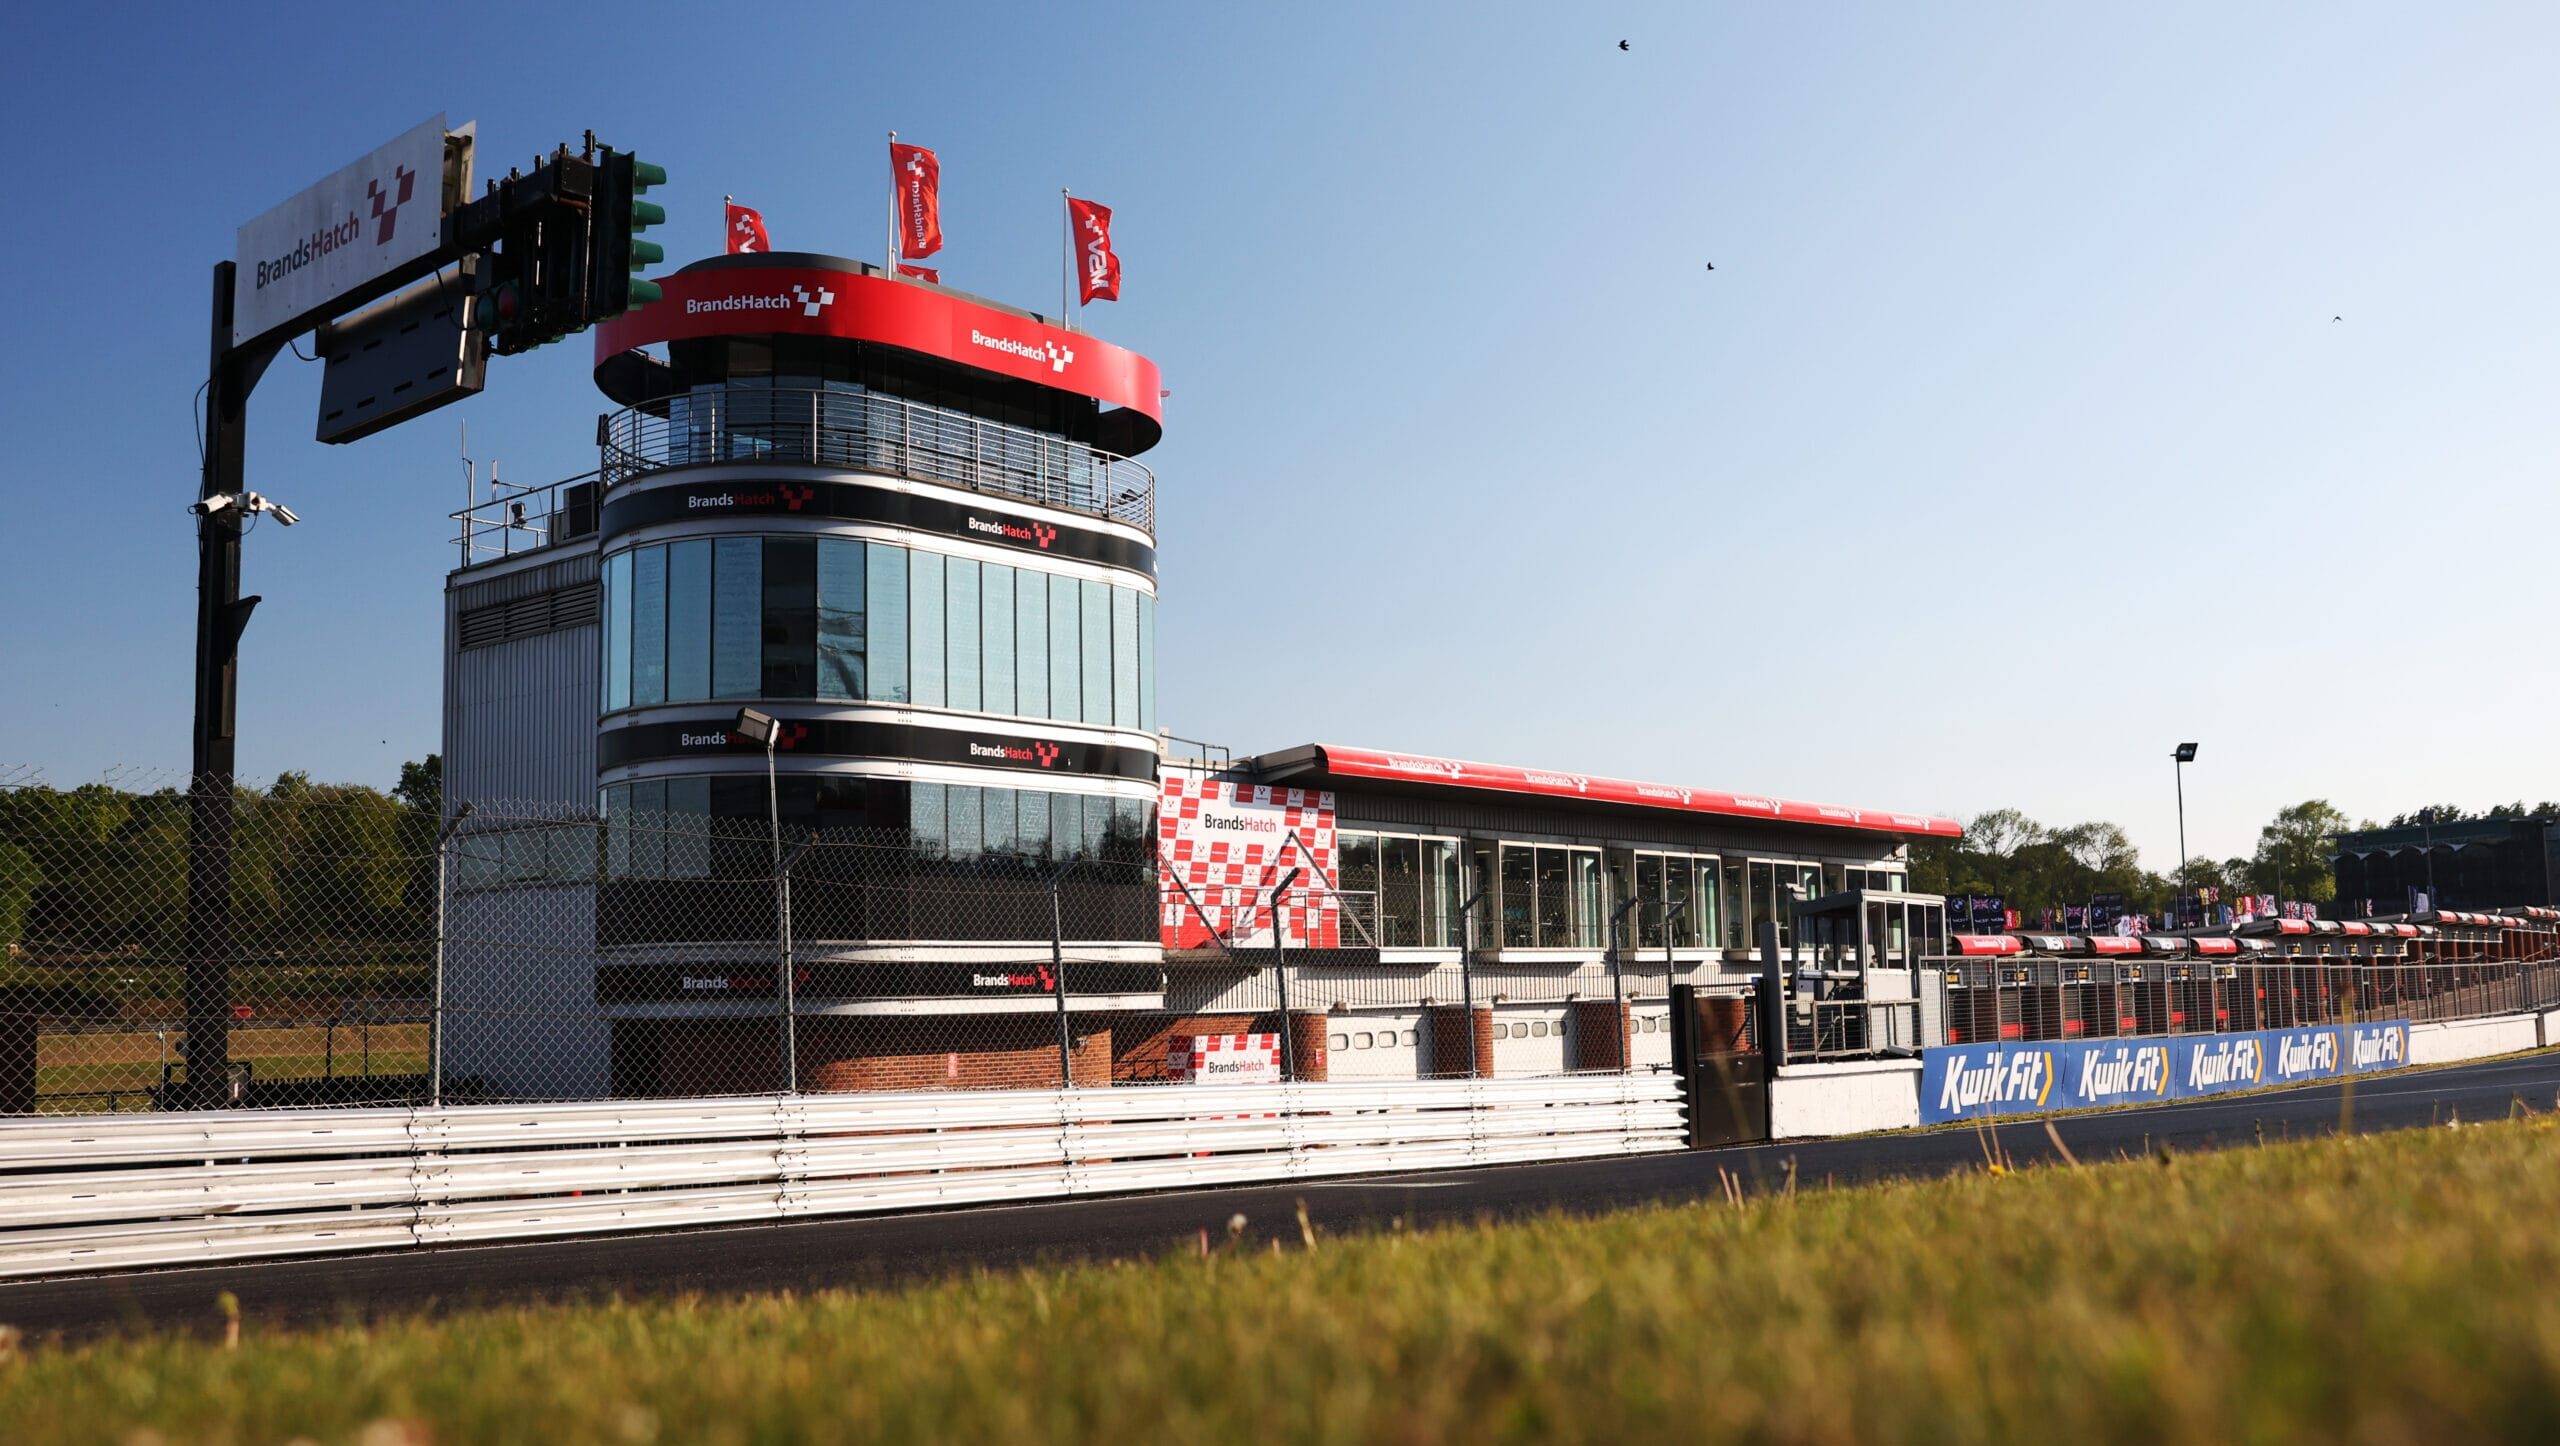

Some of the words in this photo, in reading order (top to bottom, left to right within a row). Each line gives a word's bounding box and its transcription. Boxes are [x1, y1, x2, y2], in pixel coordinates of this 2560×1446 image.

[257, 211, 359, 289] BrandsHatch
[686, 293, 791, 314] BrandsHatch
[972, 329, 1046, 362] BrandsHatch
[688, 492, 775, 509] BrandsHatch
[968, 516, 1032, 540] BrandsHatch
[970, 742, 1033, 761] BrandsHatch
[1204, 813, 1277, 833] BrandsHatch
[973, 973, 1036, 987] BrandsHatch
[1208, 1059, 1265, 1075] BrandsHatch
